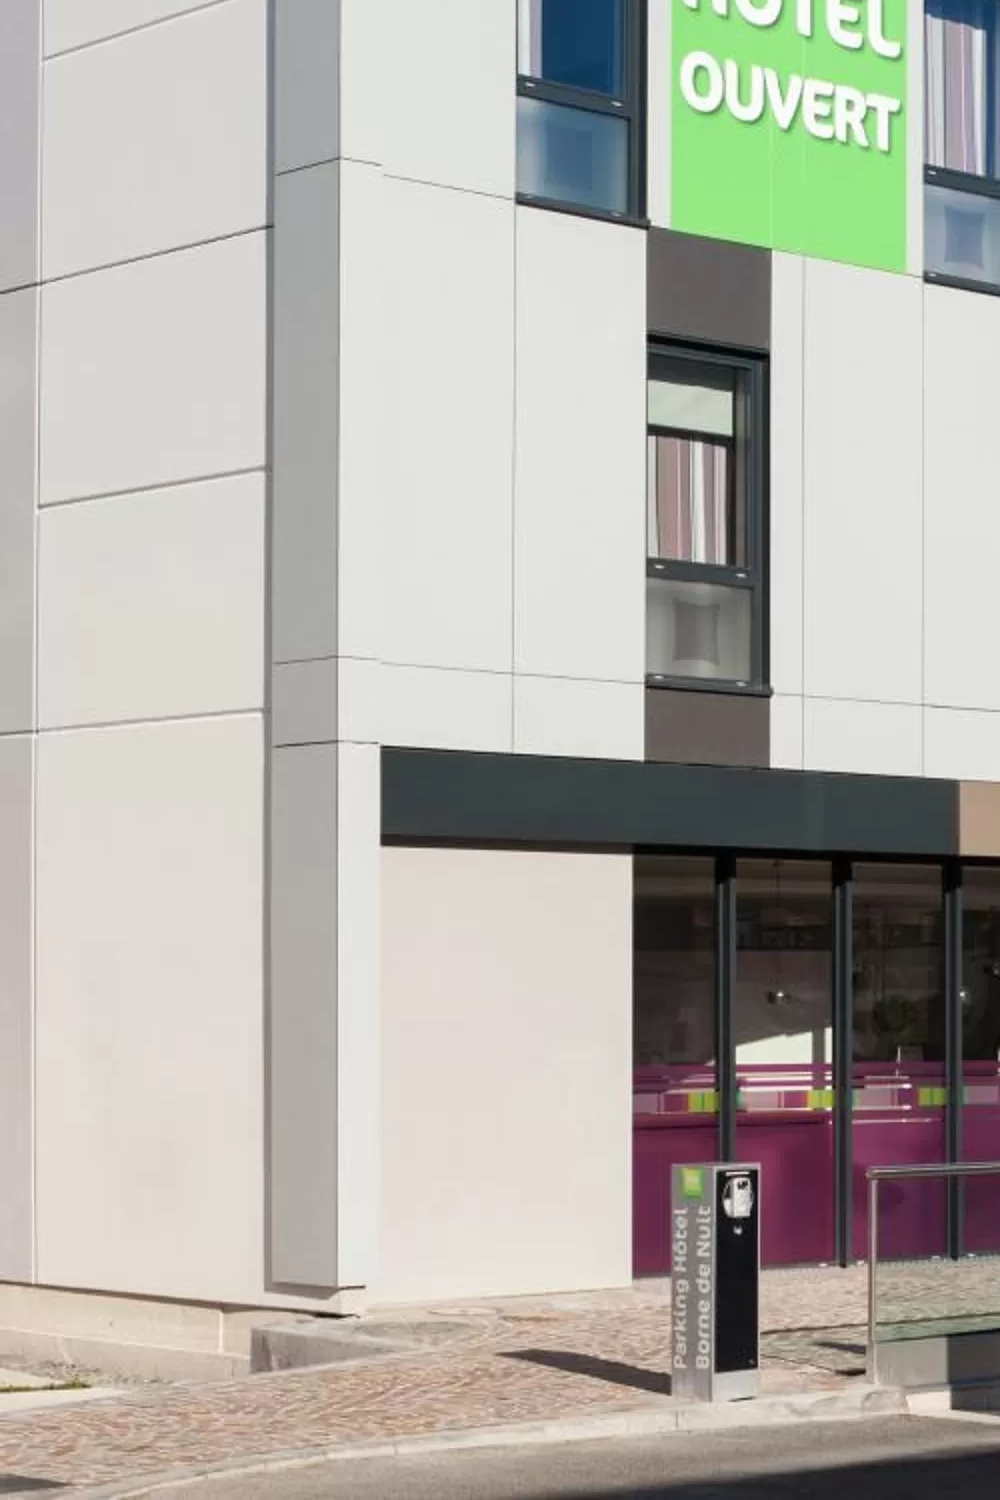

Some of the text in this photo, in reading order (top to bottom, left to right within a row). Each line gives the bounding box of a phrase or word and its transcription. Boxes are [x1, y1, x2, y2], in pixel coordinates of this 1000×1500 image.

[679, 50, 900, 153] OUVERT
[673, 1206, 689, 1369] Parking Hôtel
[695, 1203, 711, 1369] Borne de Nuit
